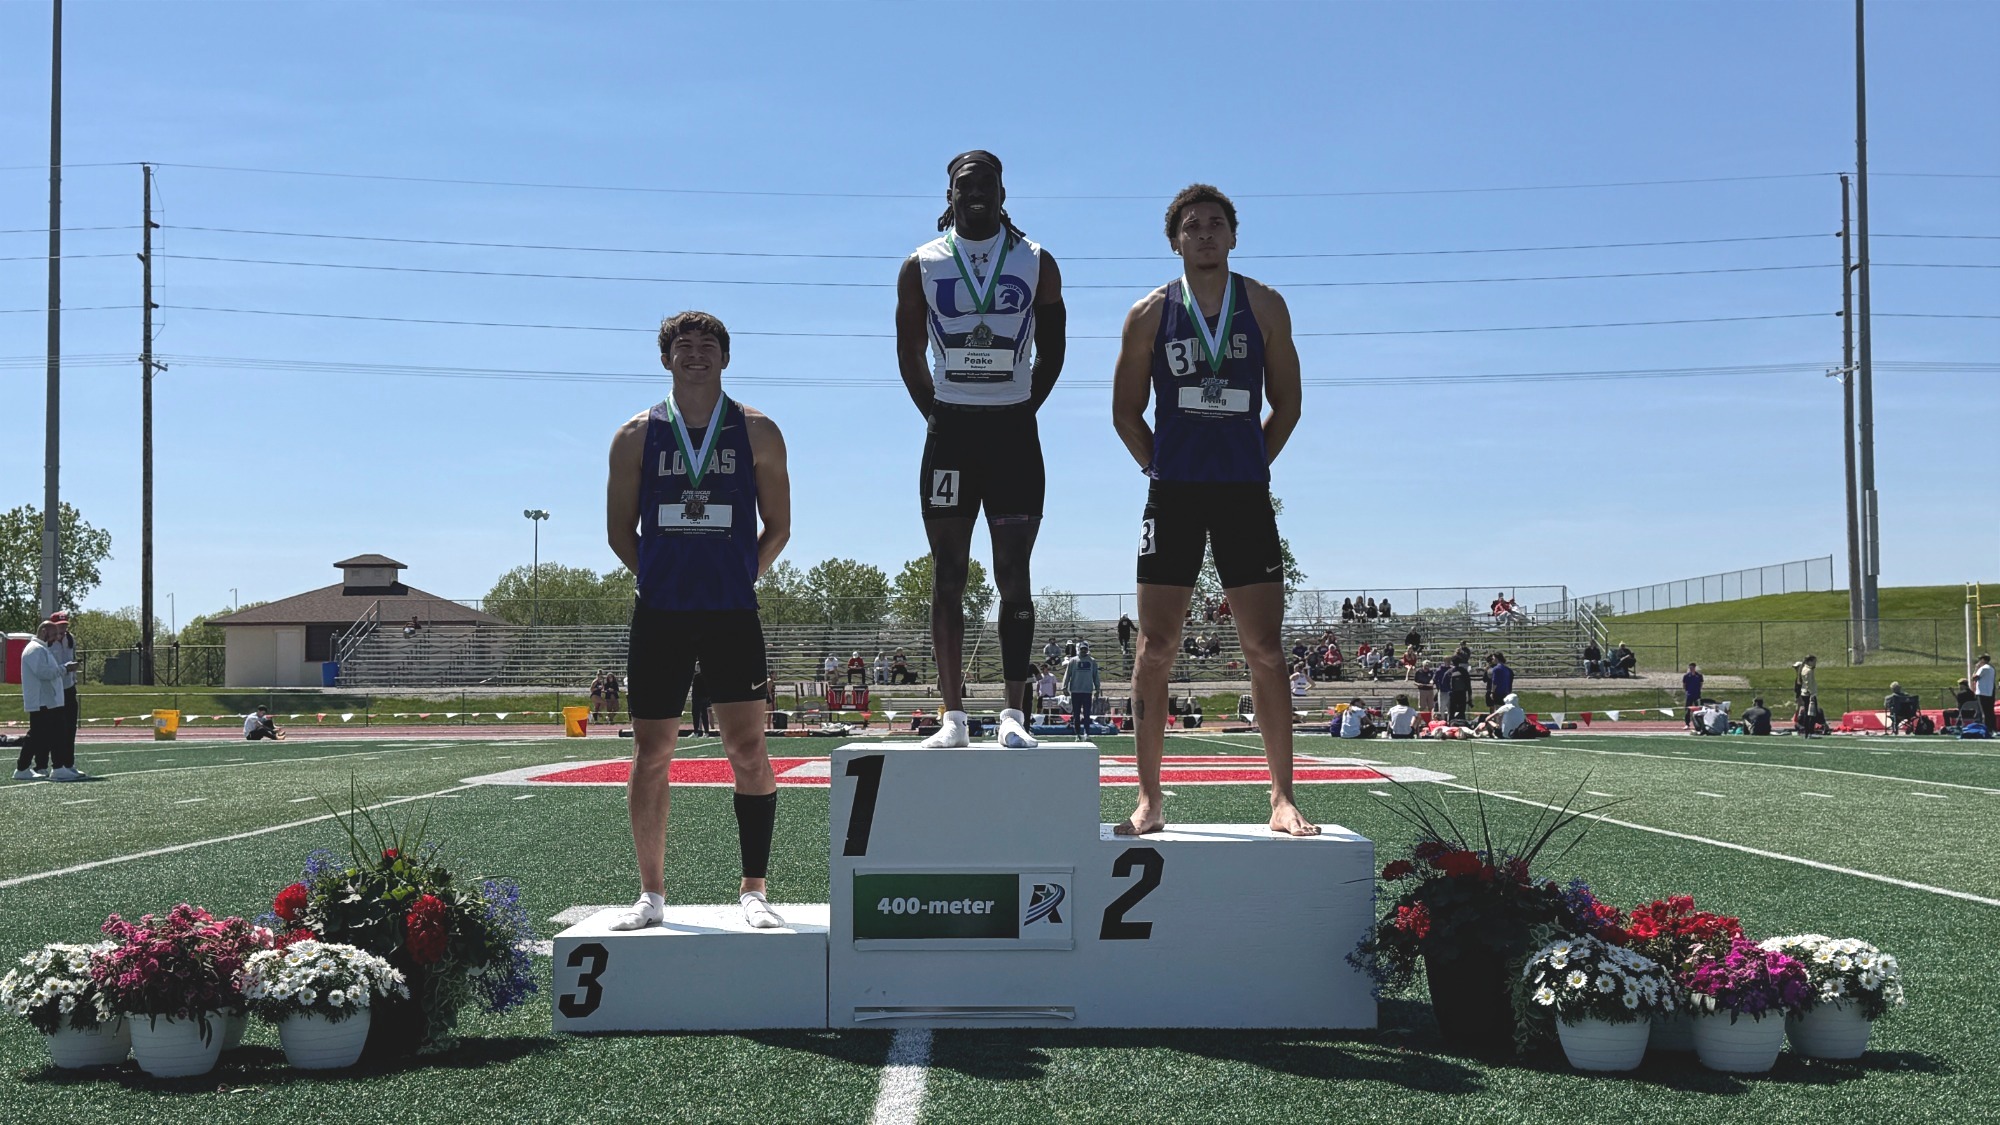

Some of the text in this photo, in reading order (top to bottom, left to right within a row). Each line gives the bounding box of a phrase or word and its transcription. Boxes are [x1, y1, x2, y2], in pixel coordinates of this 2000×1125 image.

[1171, 342, 1189, 375] 3
[658, 448, 736, 476] LOAS
[936, 472, 954, 504] 4
[1141, 521, 1151, 553] 3
[843, 755, 885, 856] 1
[876, 896, 994, 915] 400-meter
[1099, 847, 1164, 940] 2
[558, 942, 609, 1019] 3
